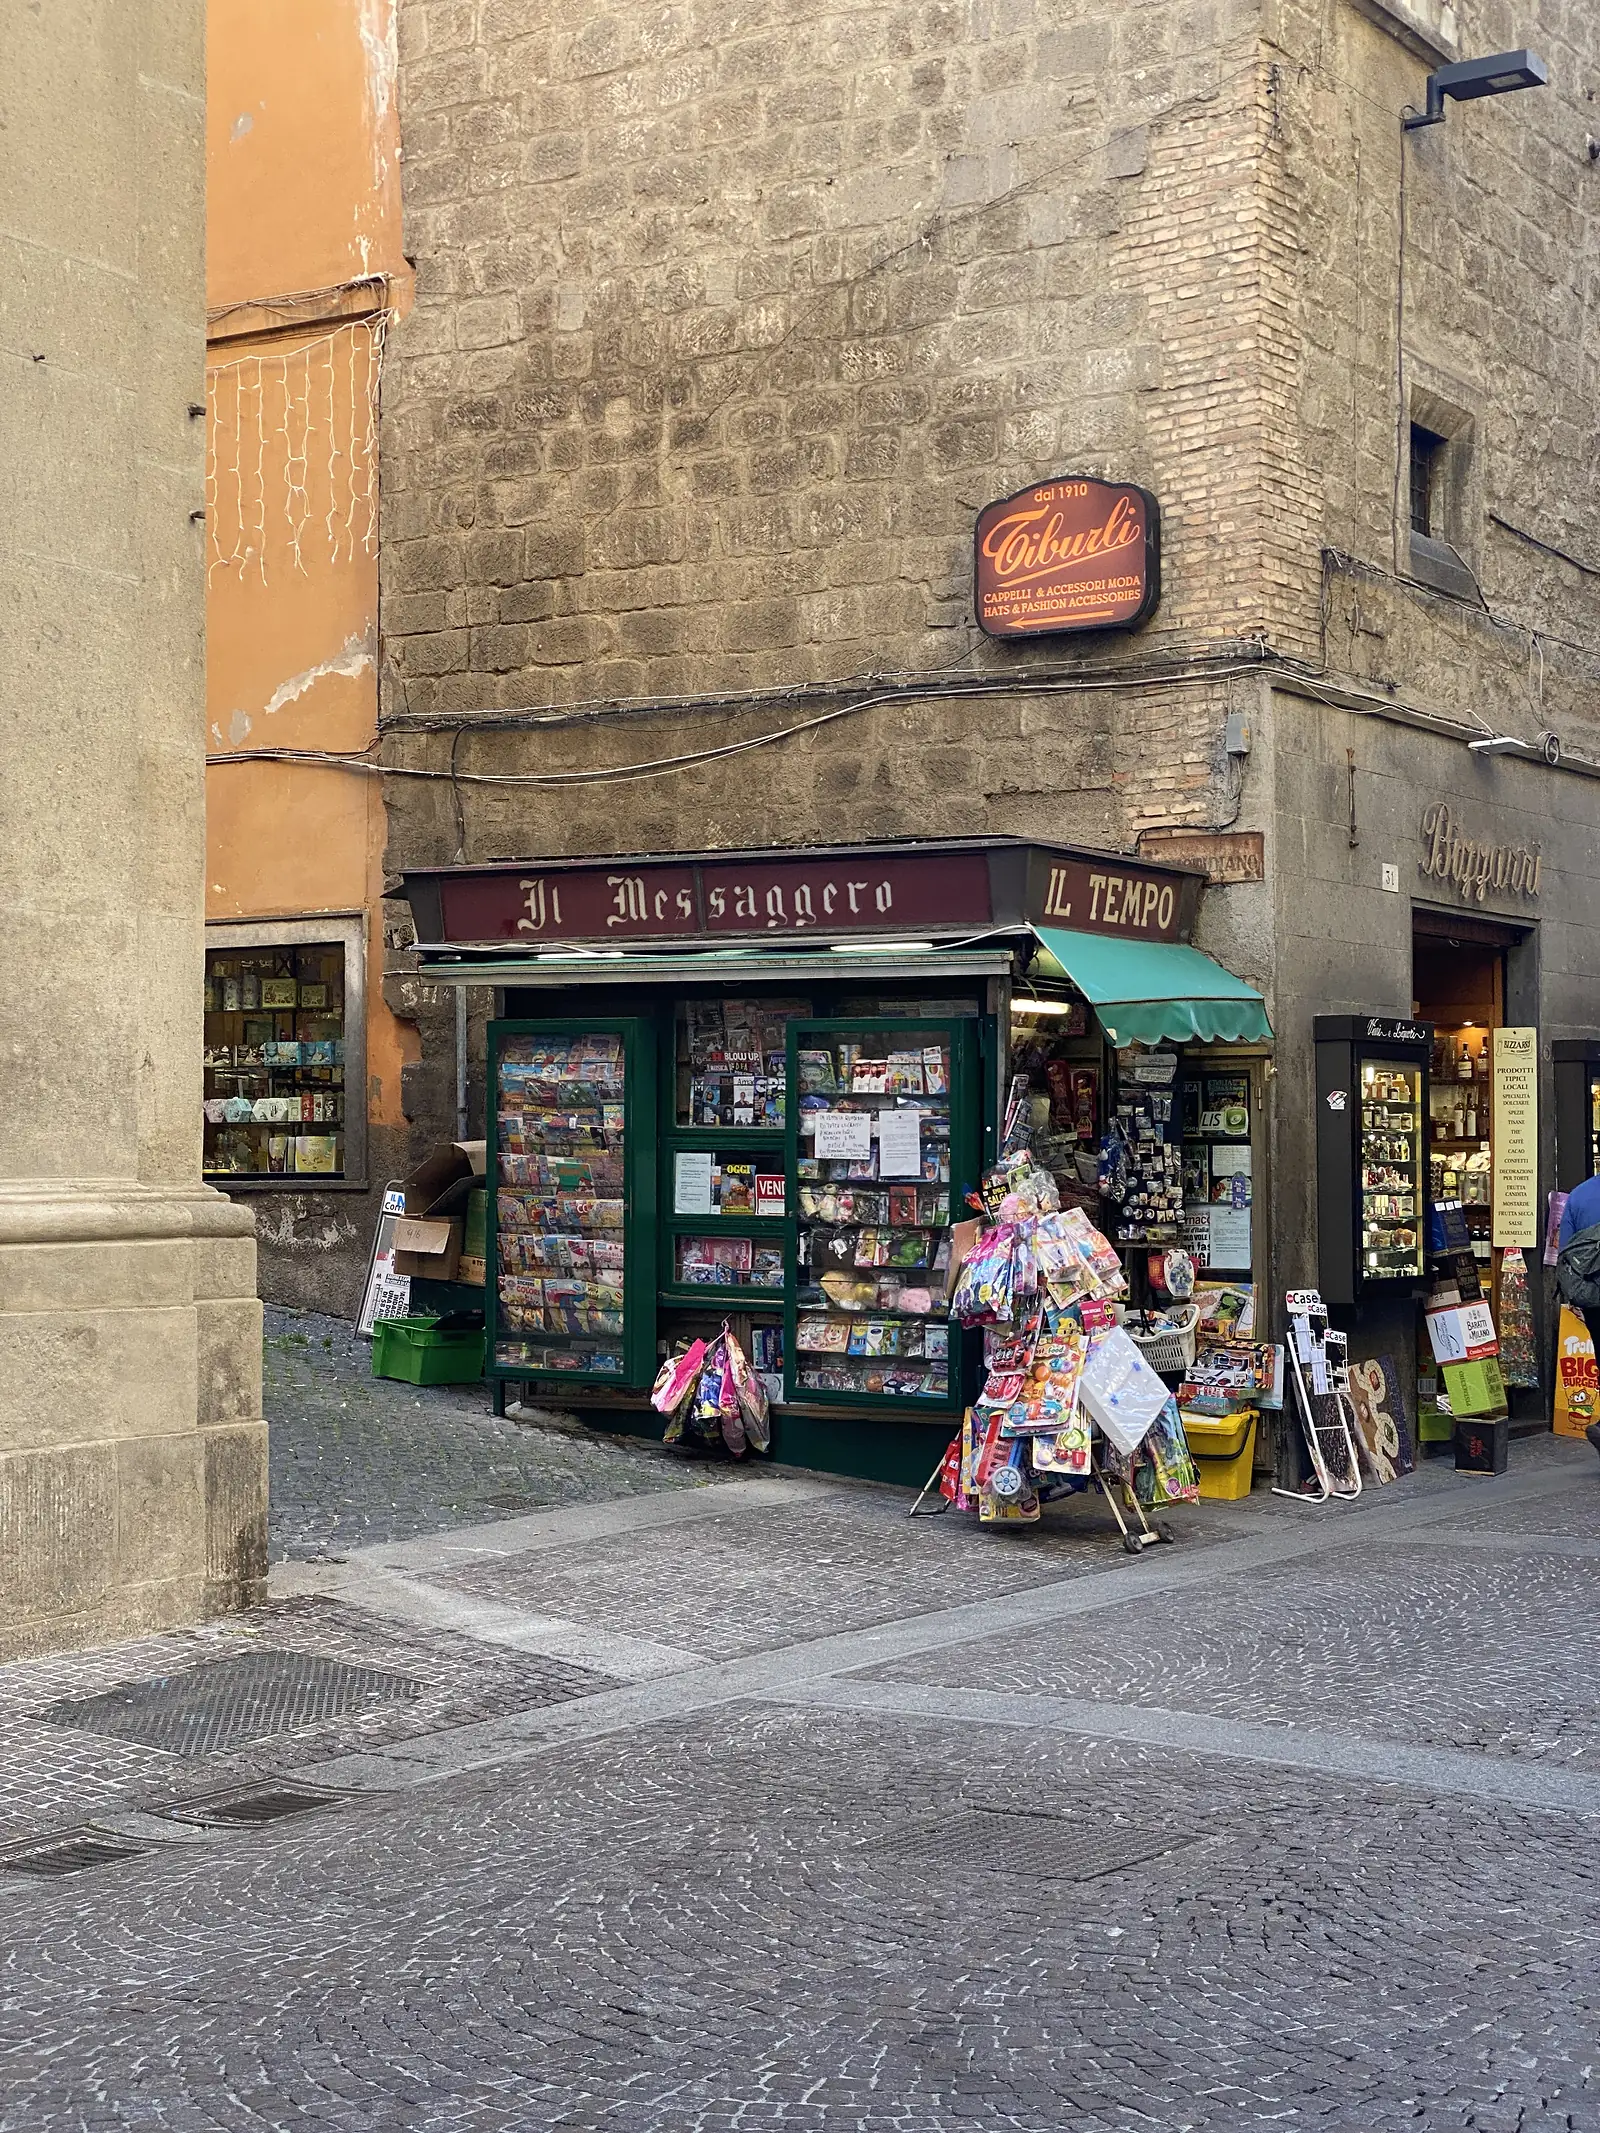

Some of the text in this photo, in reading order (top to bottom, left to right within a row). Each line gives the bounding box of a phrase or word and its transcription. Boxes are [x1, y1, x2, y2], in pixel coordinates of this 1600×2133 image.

[1034, 483, 1088, 503] dal 1910
[982, 496, 1140, 577] Tiburli
[984, 575, 1140, 604] CAPPELLI & ACCESSORI MODA
[984, 589, 1140, 618] HATS & FASHION ACCESSORIES
[1386, 870, 1395, 886] 31
[517, 876, 893, 931] Il Messaggero
[1044, 868, 1175, 930] IL TEMPO
[724, 1052, 746, 1061] BLOW
[1202, 1114, 1221, 1126] LIS
[727, 1164, 751, 1174] OGGI
[1294, 1293, 1319, 1304] Case
[1311, 1305, 1327, 1314] Case
[1466, 1319, 1487, 1331] BARATTI
[1329, 1332, 1346, 1342] Case
